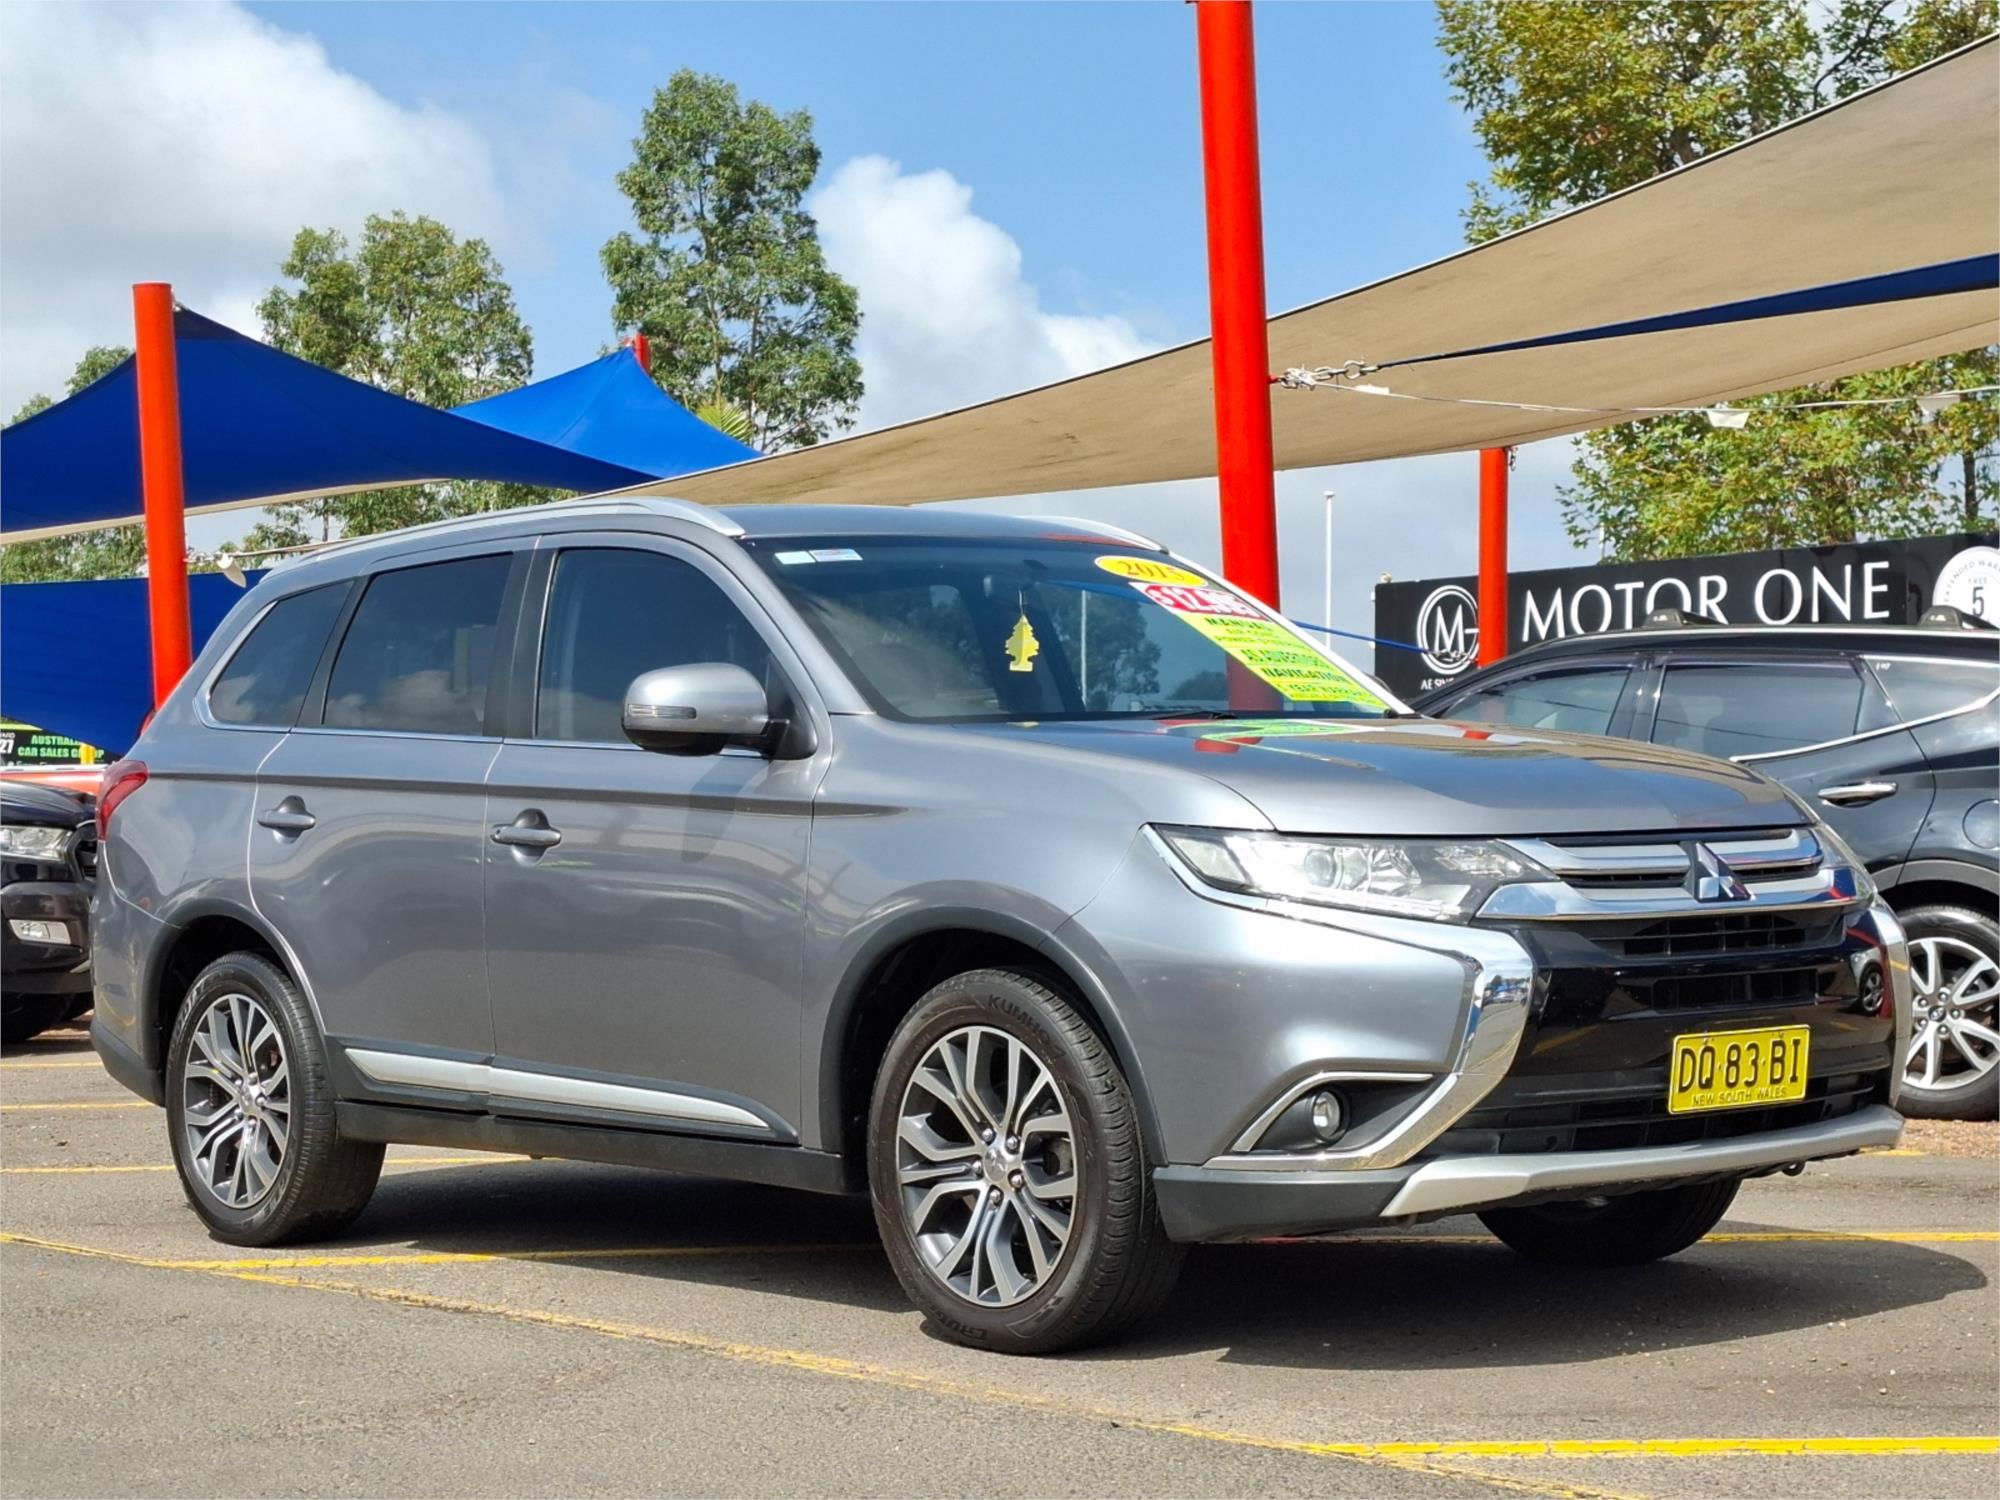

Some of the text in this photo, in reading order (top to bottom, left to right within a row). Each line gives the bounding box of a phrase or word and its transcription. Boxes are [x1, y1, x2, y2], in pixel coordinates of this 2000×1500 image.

[1522, 561, 1889, 642] MOTOR ONE
[1972, 586, 1985, 617] 5
[18, 747, 38, 757] CAR
[40, 748, 70, 758] SALES
[1692, 1086, 1786, 1106] NEW SOUTH WALES
